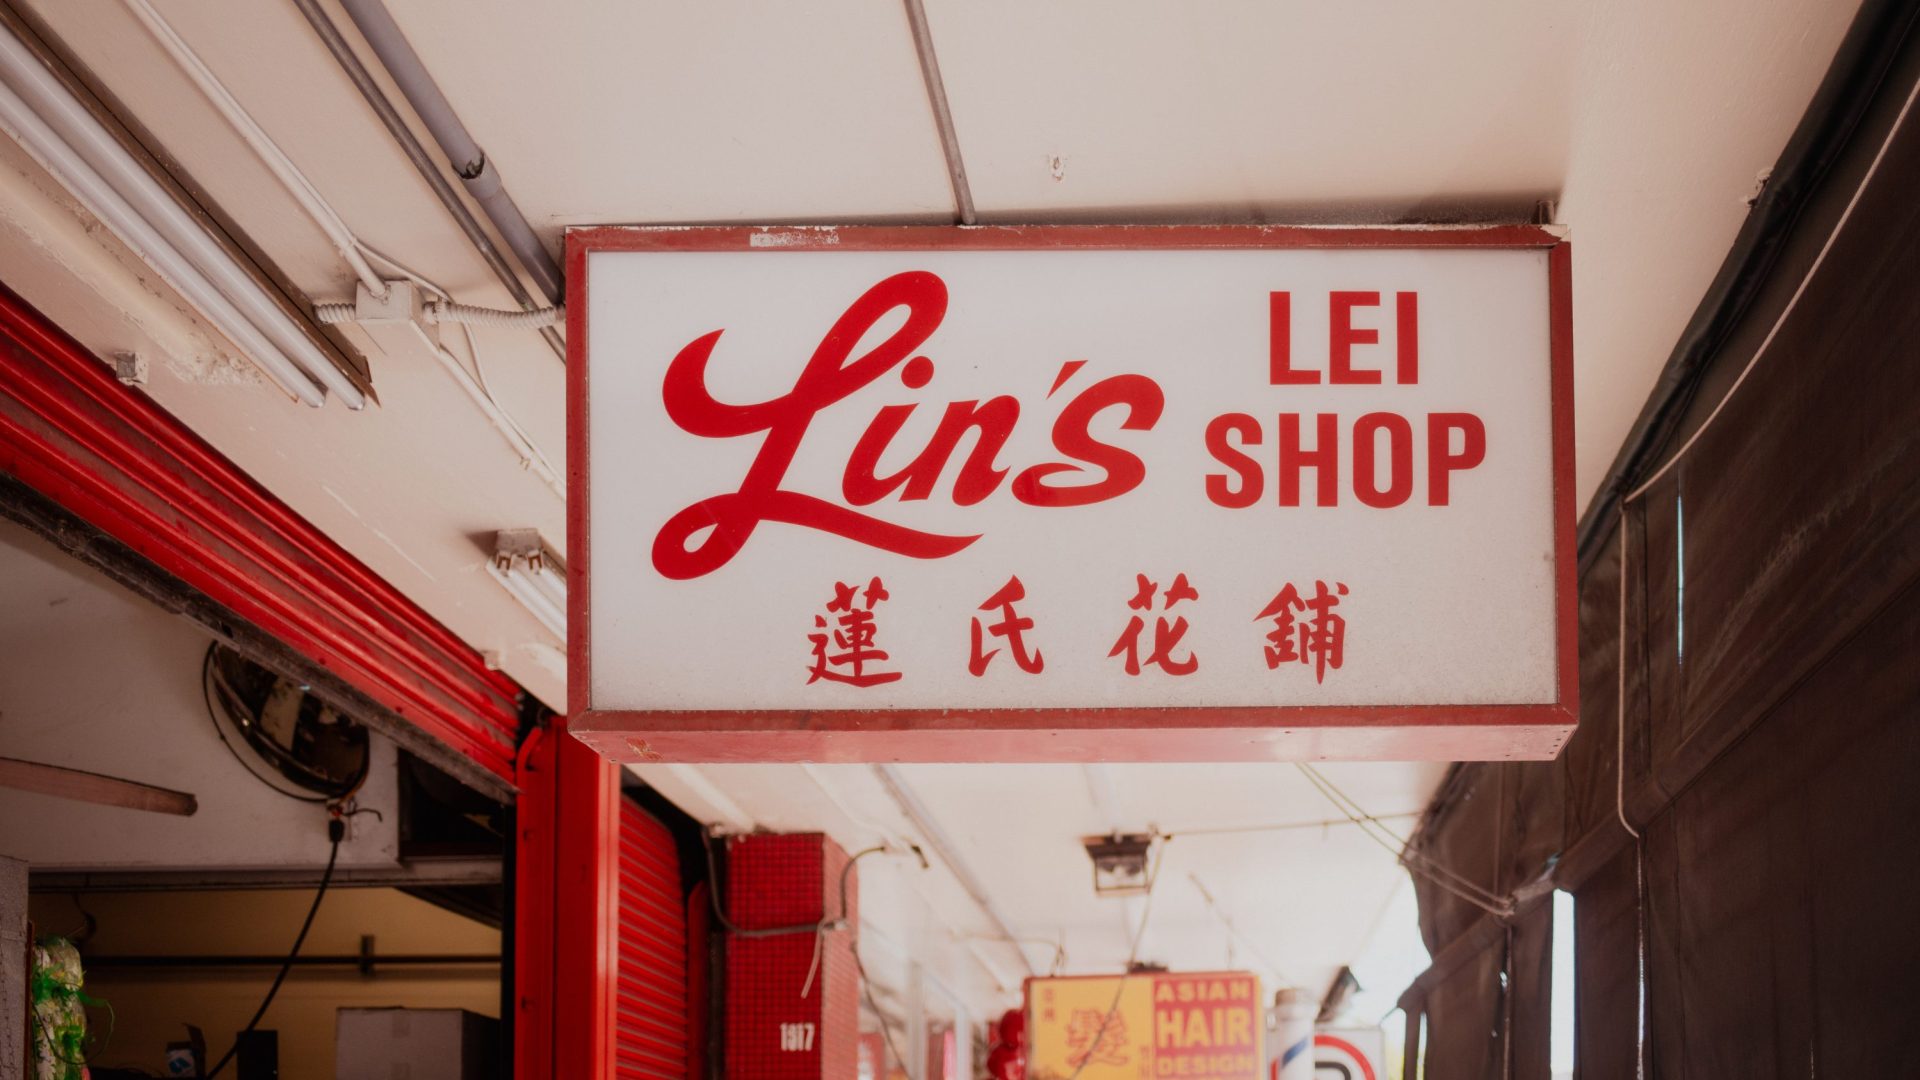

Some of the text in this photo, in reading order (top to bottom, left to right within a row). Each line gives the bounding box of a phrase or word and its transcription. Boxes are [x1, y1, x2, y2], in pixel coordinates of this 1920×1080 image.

[1269, 290, 1419, 385] LEI
[652, 271, 1164, 580] Lin's
[1205, 412, 1487, 509] SHOP
[1155, 980, 1249, 1002] ASIAN
[1156, 1008, 1251, 1048] HAIR
[1157, 1055, 1253, 1075] DESIGN
